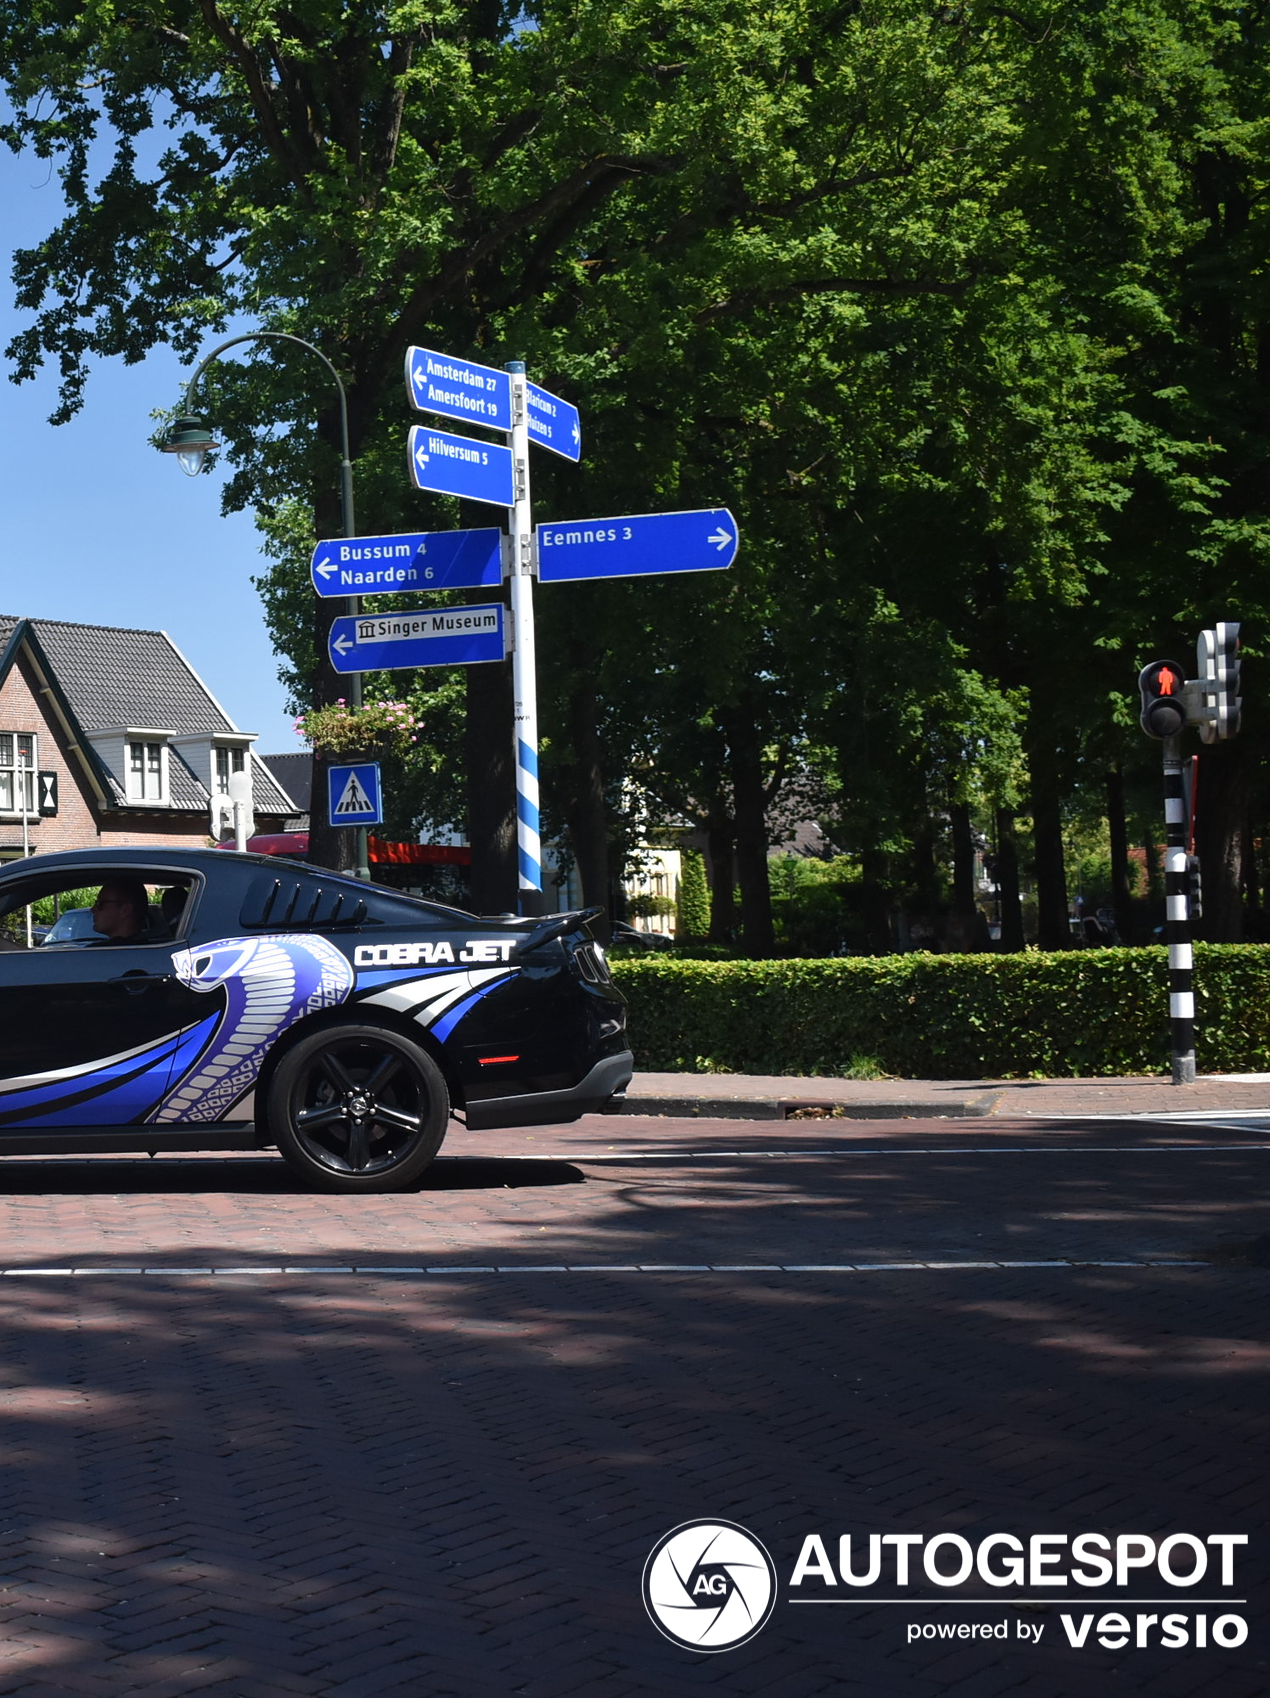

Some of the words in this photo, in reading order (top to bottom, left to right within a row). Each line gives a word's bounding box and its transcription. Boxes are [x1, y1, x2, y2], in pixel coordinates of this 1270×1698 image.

[426, 358, 484, 389] Amsterdam
[486, 377, 497, 392] 27
[427, 383, 486, 414] Amersfoort
[487, 403, 498, 417] 19
[552, 404, 557, 418] 2
[547, 425, 552, 439] 5
[428, 436, 480, 464] Hilversum
[482, 452, 488, 466] 5
[543, 528, 617, 547] Eemnes
[622, 526, 632, 540] 3
[340, 544, 411, 562] Bussum
[417, 542, 427, 556] 4
[340, 566, 418, 586] Naarden
[424, 566, 434, 579] 6
[378, 620, 428, 637] Singer
[432, 614, 496, 632] Museum
[354, 942, 455, 967] COBRA
[459, 939, 517, 962] JET
